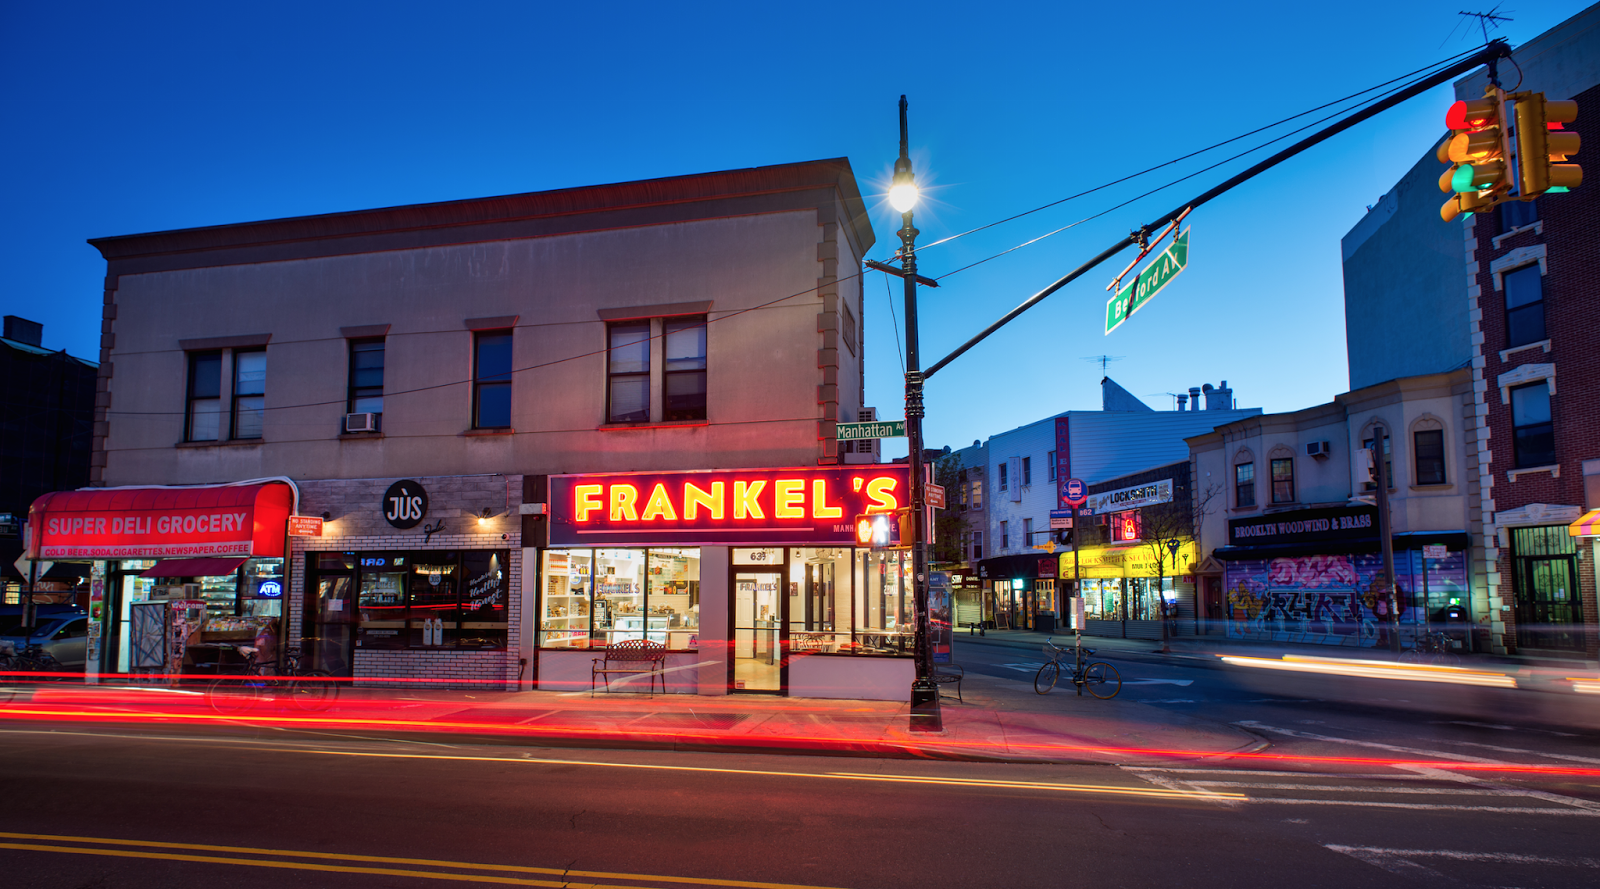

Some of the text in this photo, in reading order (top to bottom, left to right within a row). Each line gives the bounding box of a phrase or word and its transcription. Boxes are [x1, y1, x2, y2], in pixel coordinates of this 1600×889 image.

[837, 424, 893, 439] Manhattan
[386, 487, 423, 520] JÙS
[574, 476, 898, 522] FRANKEL'S
[1109, 484, 1158, 504] LOCKSMITH
[48, 512, 247, 536] SUPER DELI GROCERY
[1234, 514, 1372, 538] BROOKLYN WOODWIND & BRASS
[45, 549, 66, 557] COLD
[259, 584, 281, 594] ATM
